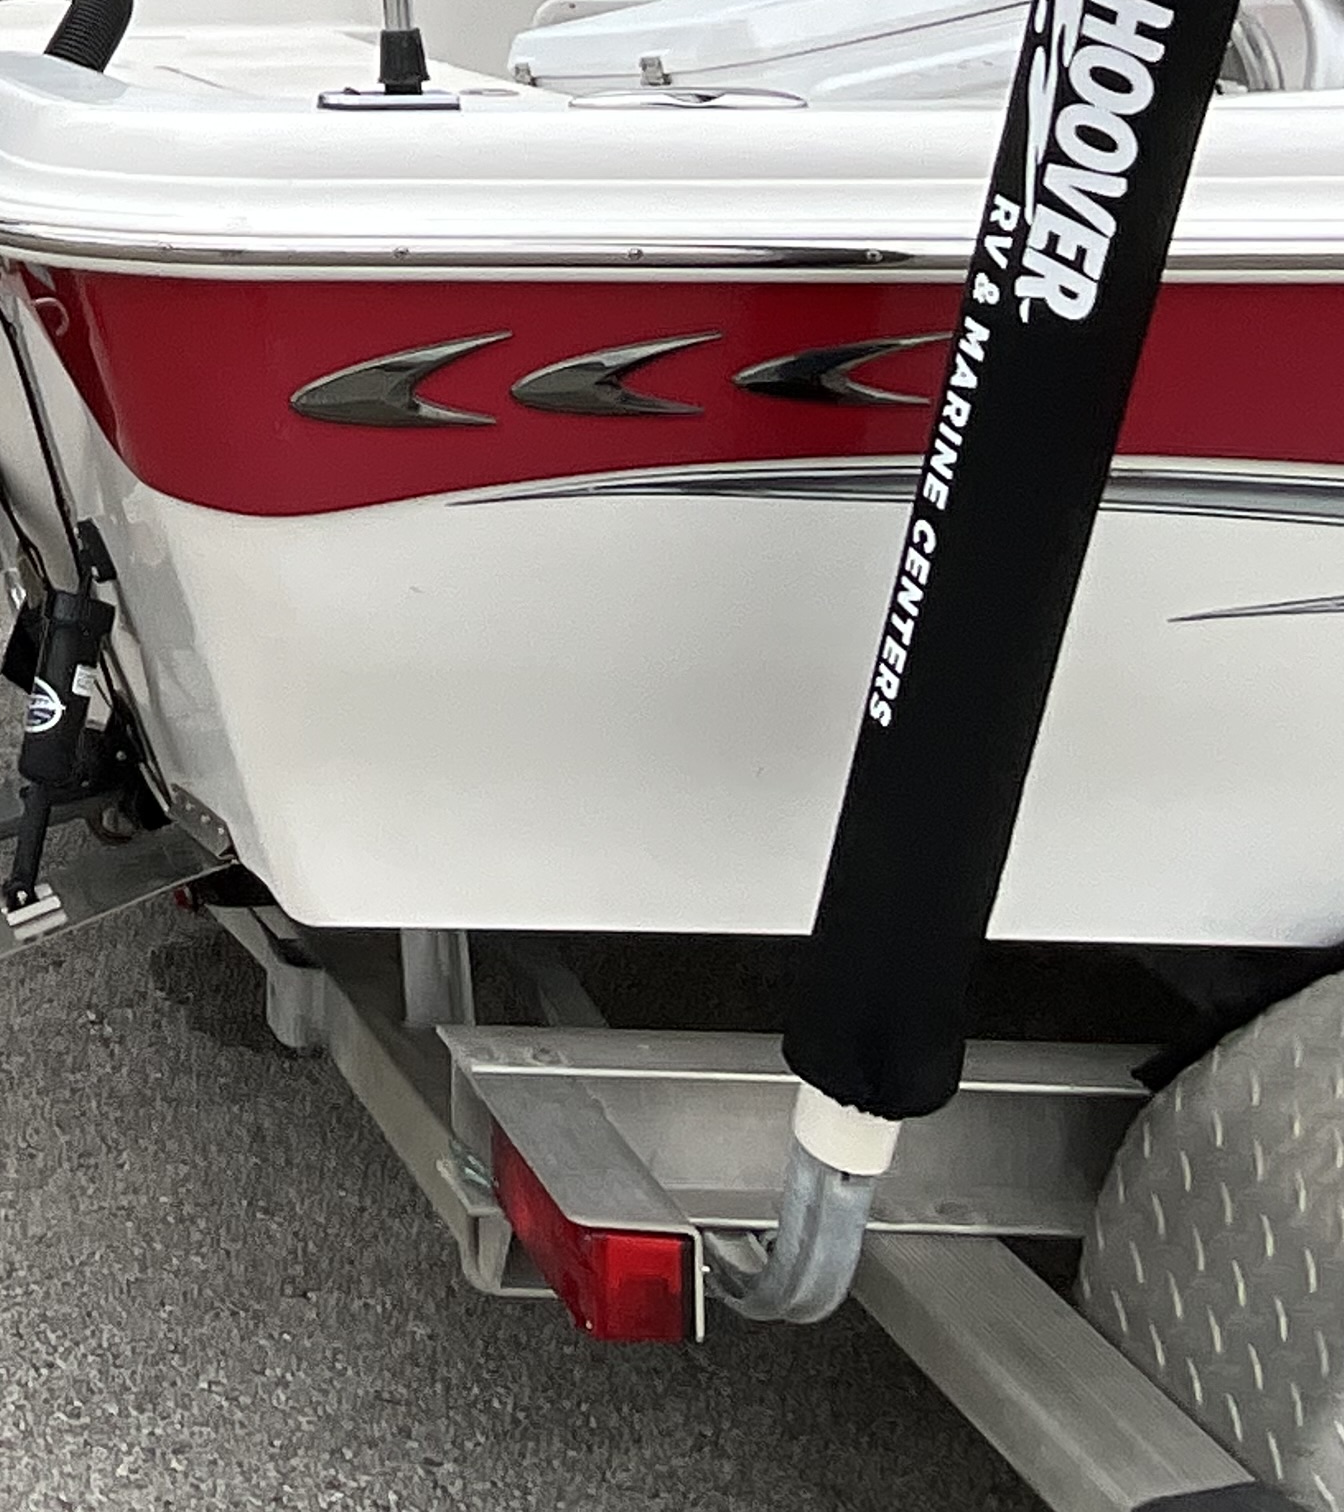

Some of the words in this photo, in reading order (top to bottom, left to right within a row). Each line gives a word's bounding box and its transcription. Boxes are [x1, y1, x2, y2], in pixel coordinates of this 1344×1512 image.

[972, 271, 1001, 306] &
[984, 192, 1021, 270] RV
[921, 315, 992, 511] MARINE
[869, 518, 938, 728] CENTERS
